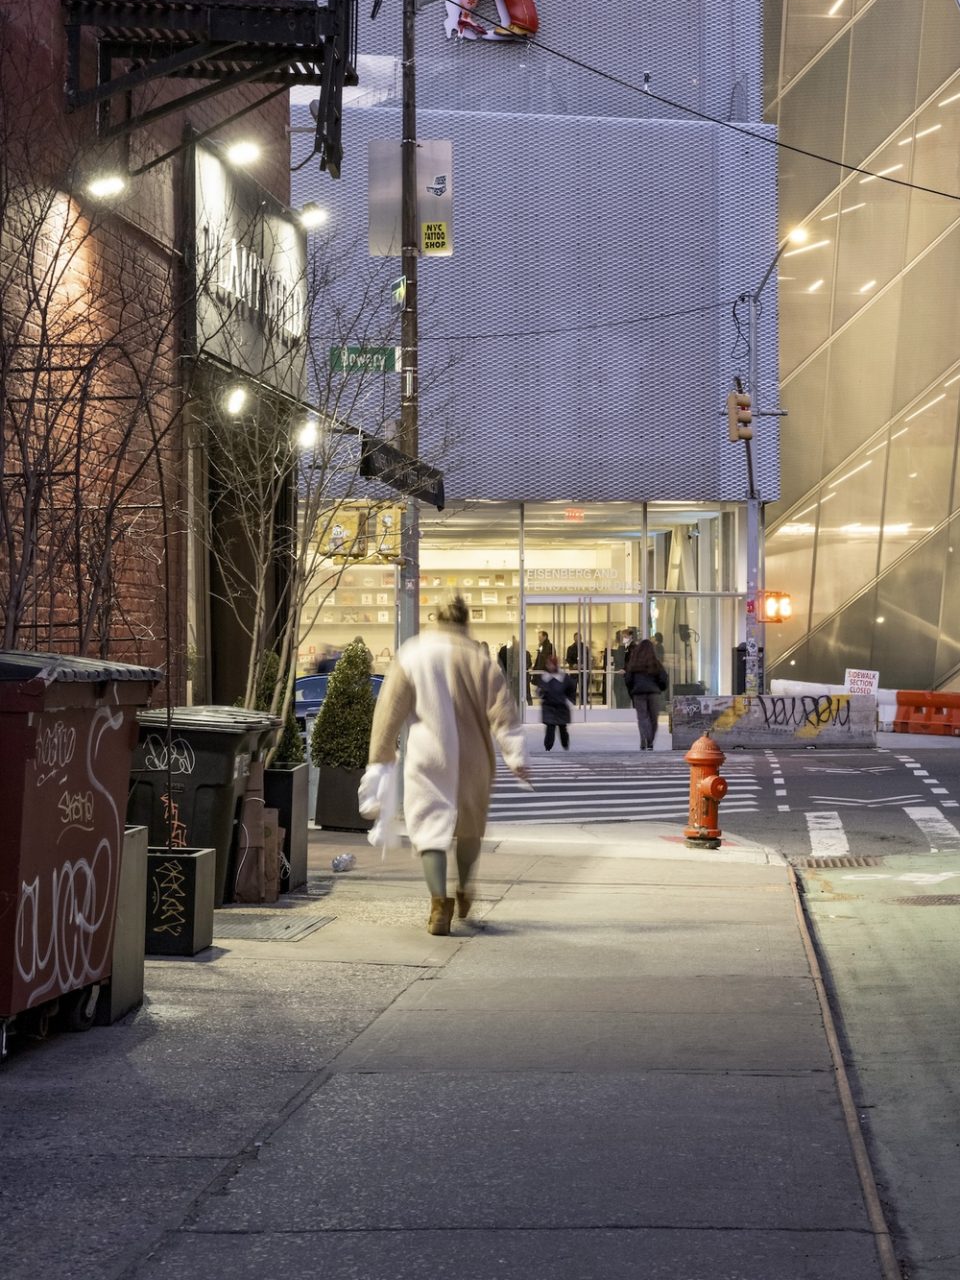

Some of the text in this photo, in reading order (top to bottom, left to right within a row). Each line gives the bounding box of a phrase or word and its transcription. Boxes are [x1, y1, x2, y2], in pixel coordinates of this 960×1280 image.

[424, 232, 446, 240] TATTOO
[424, 241, 446, 249] SHOP
[341, 346, 386, 371] Bowery
[527, 568, 618, 579] EISENBERG AND
[527, 581, 585, 591] FEINSTEIN
[848, 670, 877, 680] SIDEWALK
[849, 679, 874, 687] SECTION
[849, 686, 872, 695] CLOSED
